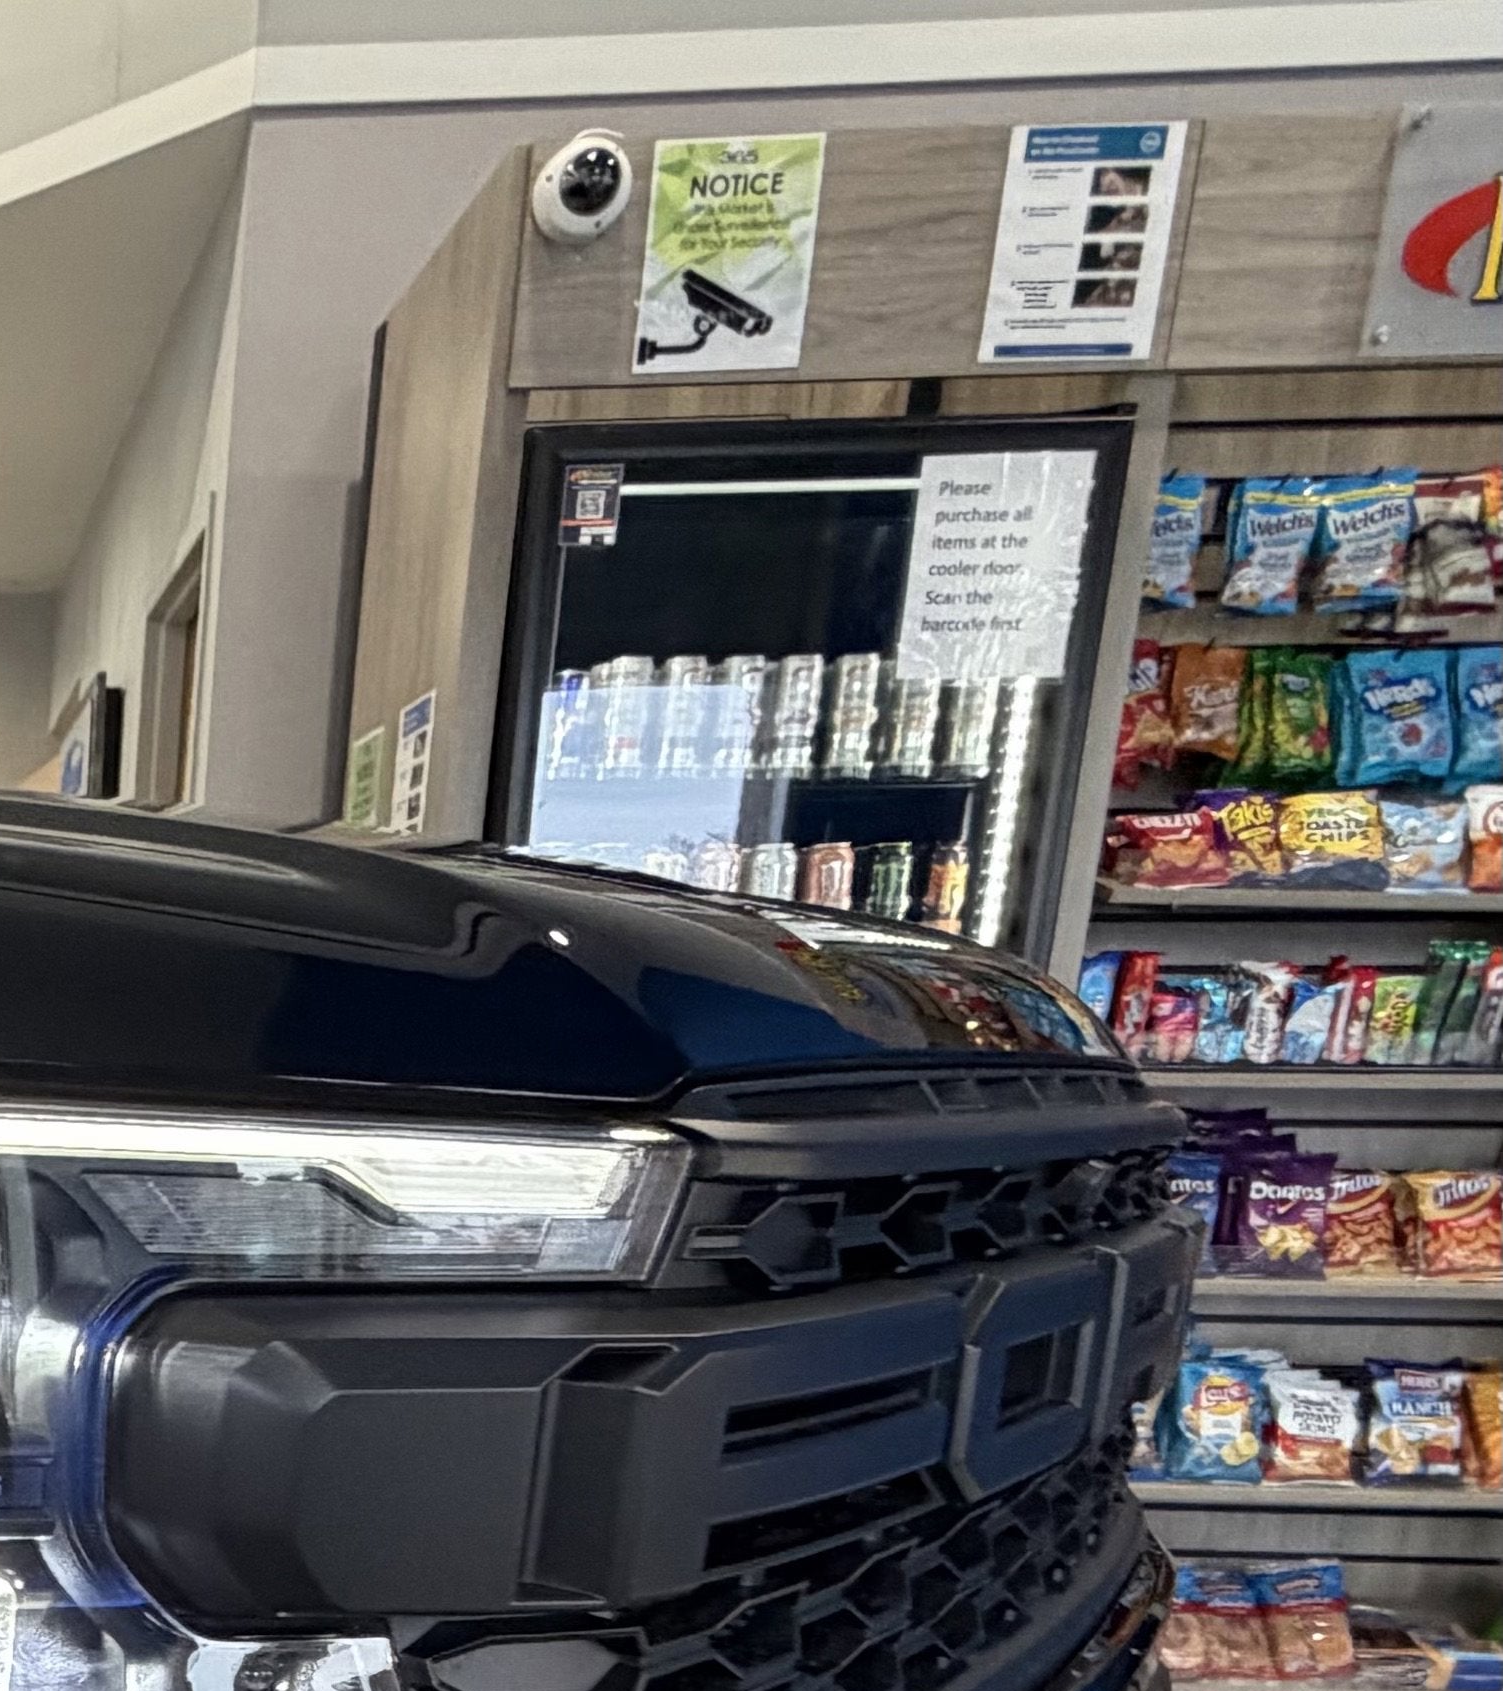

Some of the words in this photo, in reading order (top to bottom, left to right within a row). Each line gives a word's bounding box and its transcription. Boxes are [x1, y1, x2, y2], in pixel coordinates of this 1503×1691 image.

[690, 172, 785, 199] NOTICE
[939, 480, 992, 497] Please
[935, 508, 1010, 527] purchase
[1013, 505, 1034, 521] all
[932, 535, 976, 551] items
[981, 535, 997, 550] at
[1001, 533, 1029, 549] the
[928, 560, 981, 577] cooler
[925, 590, 962, 606] Scan
[966, 590, 993, 606] the
[921, 616, 986, 633] barcode
[1305, 830, 1372, 844] CHIPS
[1250, 1180, 1326, 1201] Doritos
